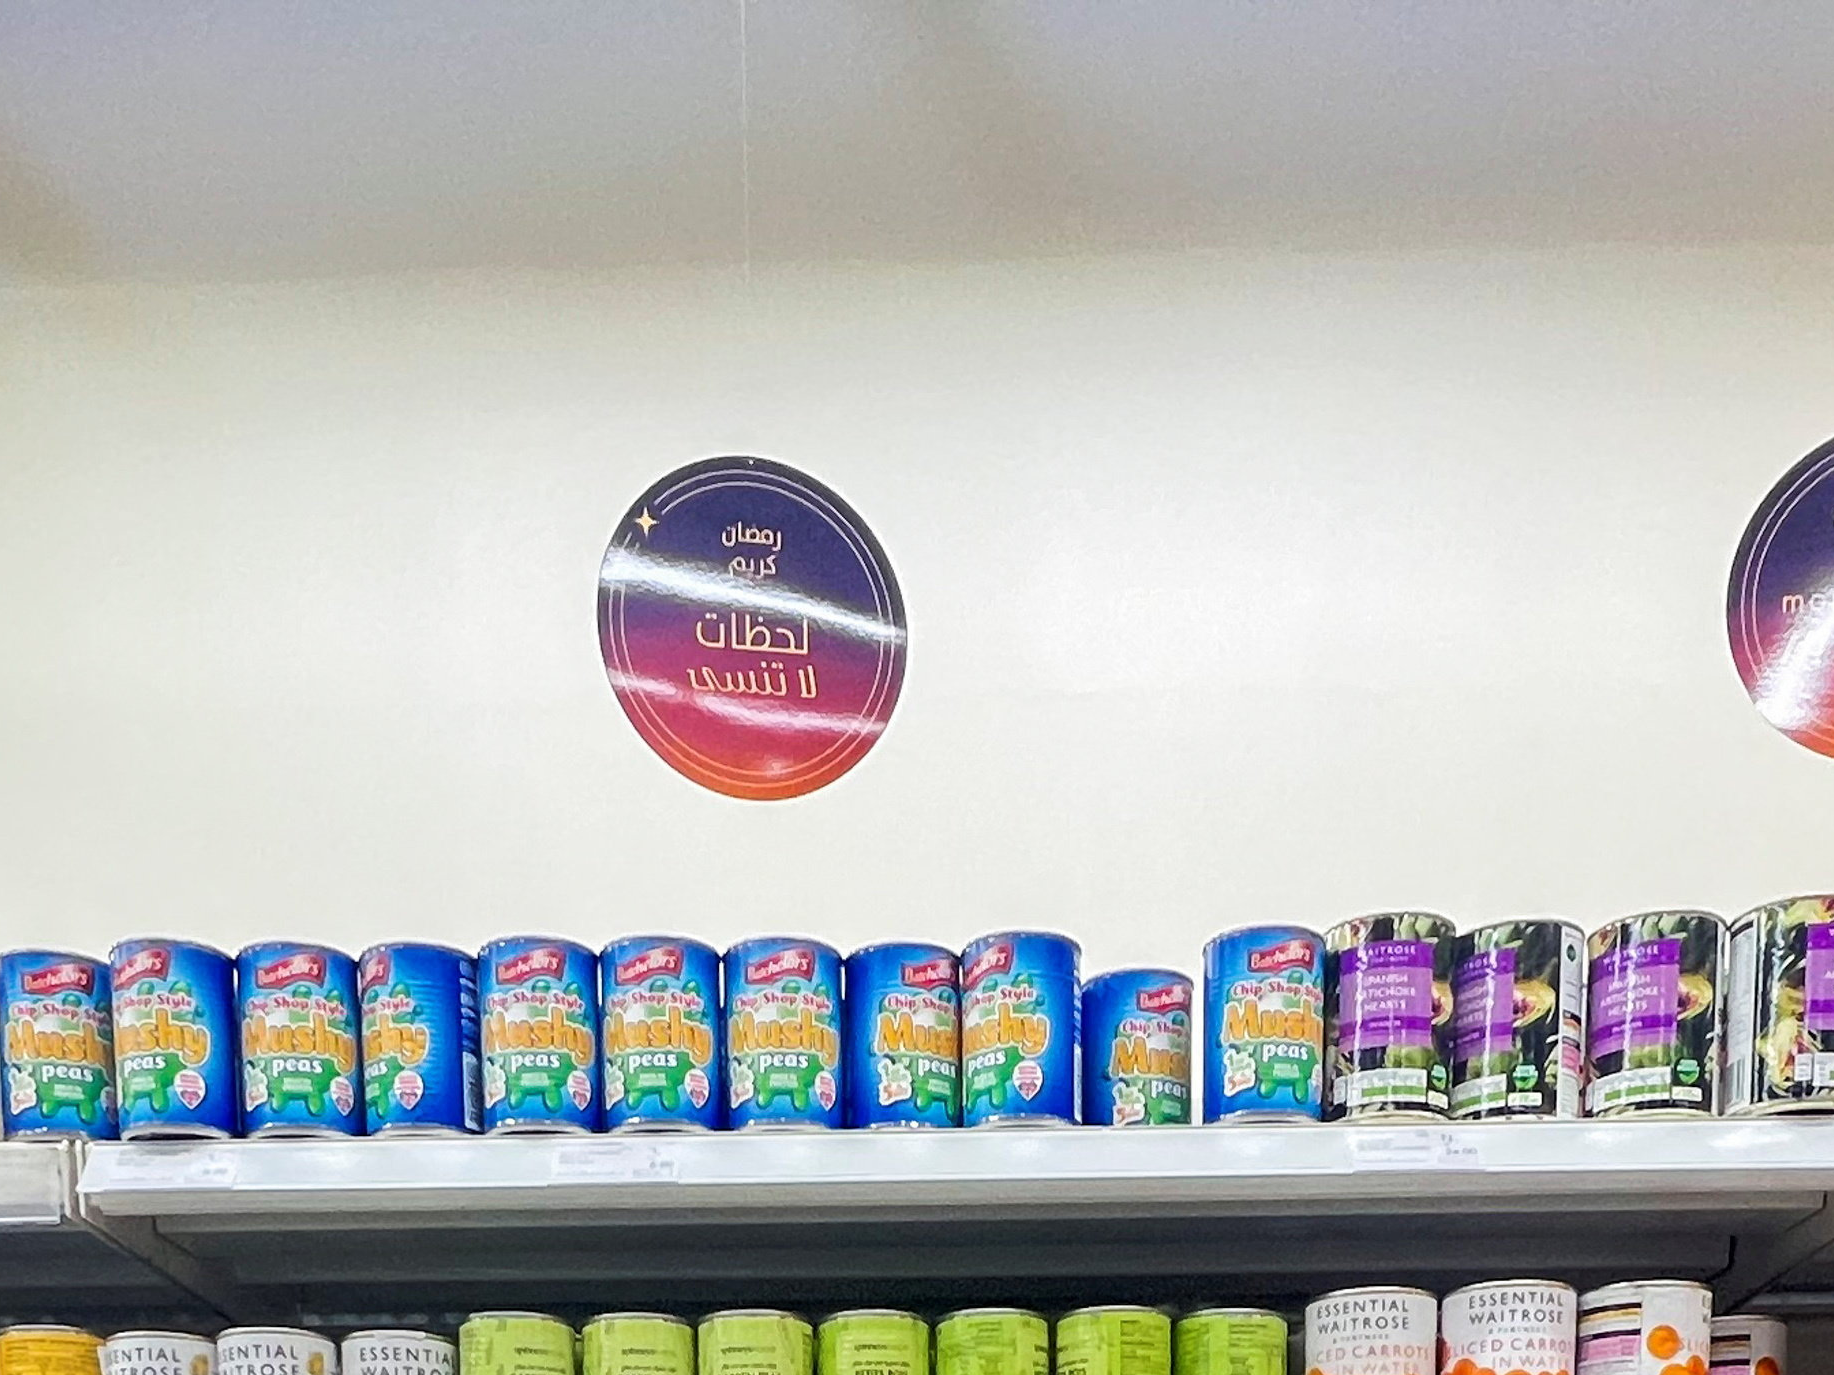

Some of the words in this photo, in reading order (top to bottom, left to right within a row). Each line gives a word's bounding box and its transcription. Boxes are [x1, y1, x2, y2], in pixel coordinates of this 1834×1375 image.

[721, 521, 782, 551] رمضان
[728, 555, 778, 578] كريم
[696, 611, 812, 656] لحظات
[1266, 982, 1302, 999] Shop
[1262, 1041, 1309, 1062] peas
[272, 1057, 323, 1077] peas
[511, 1052, 561, 1073] peas
[759, 1052, 809, 1073] peas
[41, 1063, 94, 1084] peas
[1317, 1299, 1409, 1319] ESSENTIAL
[1469, 1291, 1564, 1309] ESSENTIAL
[1317, 1316, 1410, 1334] WAITROSE
[1469, 1308, 1564, 1325] WAITROSE
